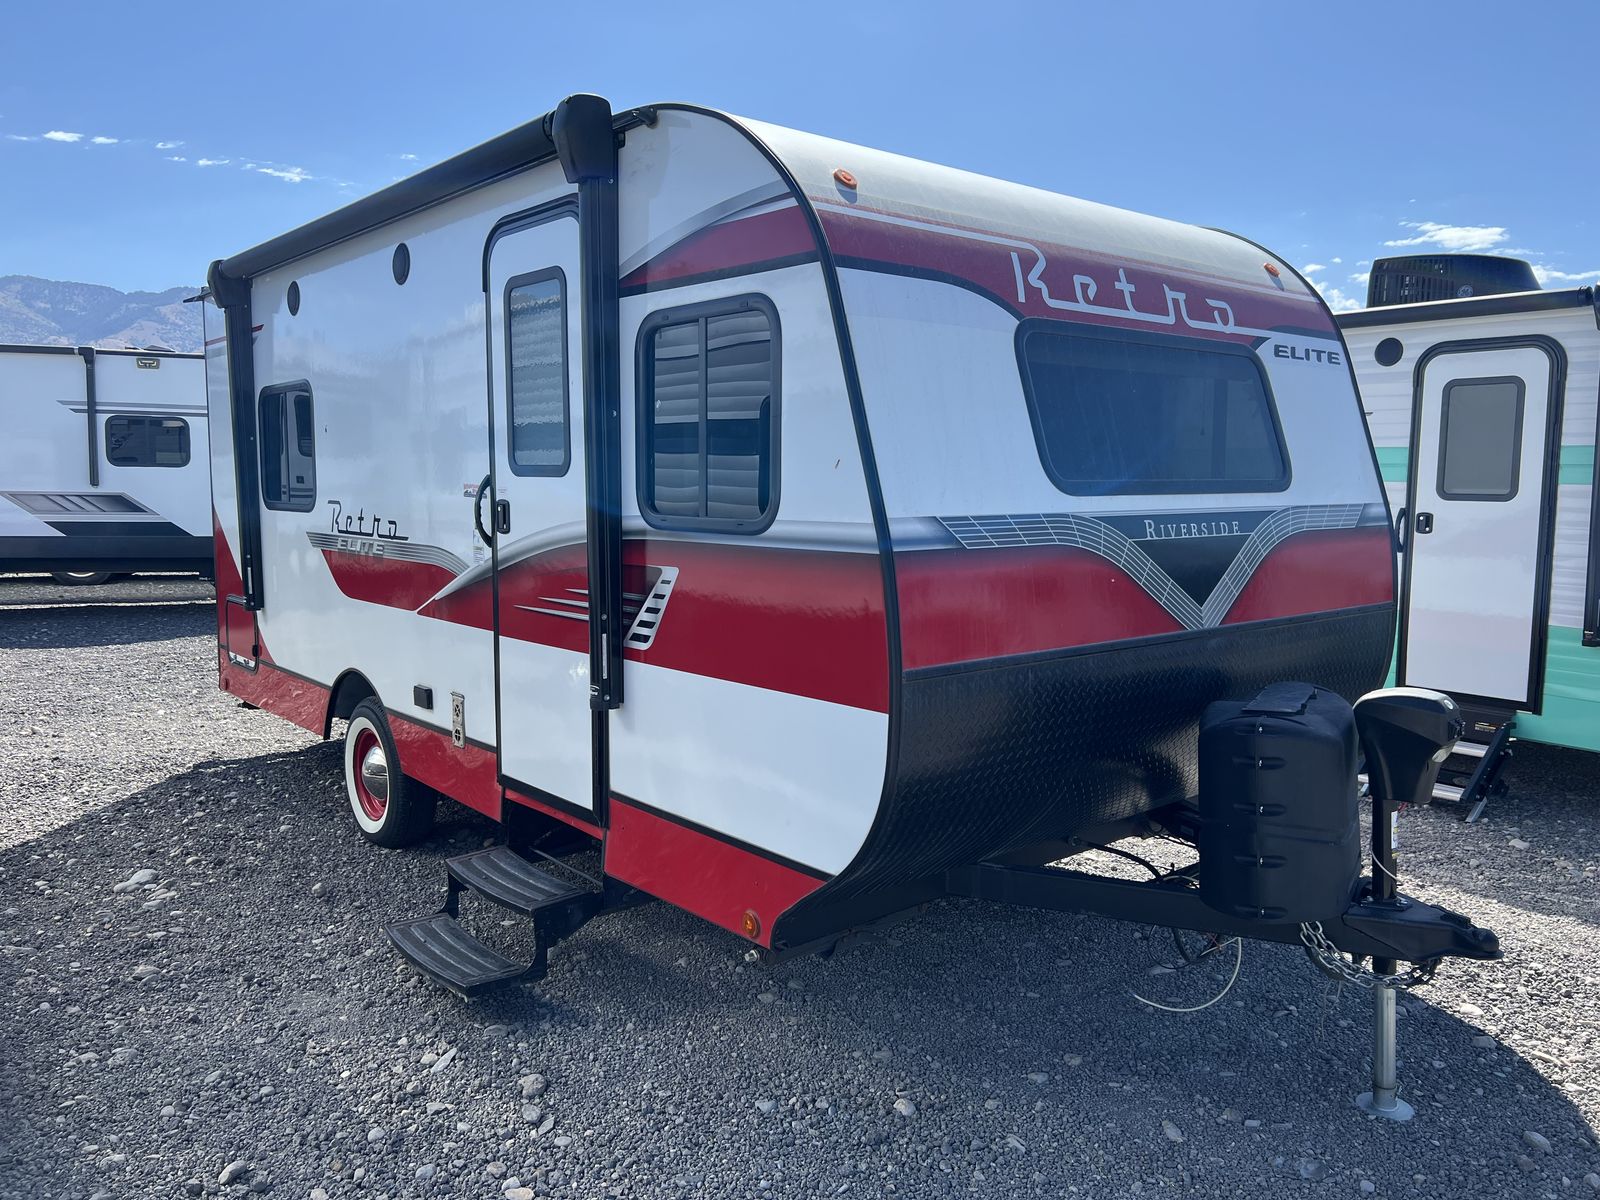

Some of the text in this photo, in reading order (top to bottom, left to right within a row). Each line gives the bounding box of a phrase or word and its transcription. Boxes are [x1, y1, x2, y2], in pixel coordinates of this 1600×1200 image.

[1009, 242, 1238, 334] Retro
[1273, 343, 1342, 366] ELITE
[328, 500, 409, 541] Retro
[1143, 519, 1241, 540] RIVERSIDE
[337, 538, 385, 554] ELITE
